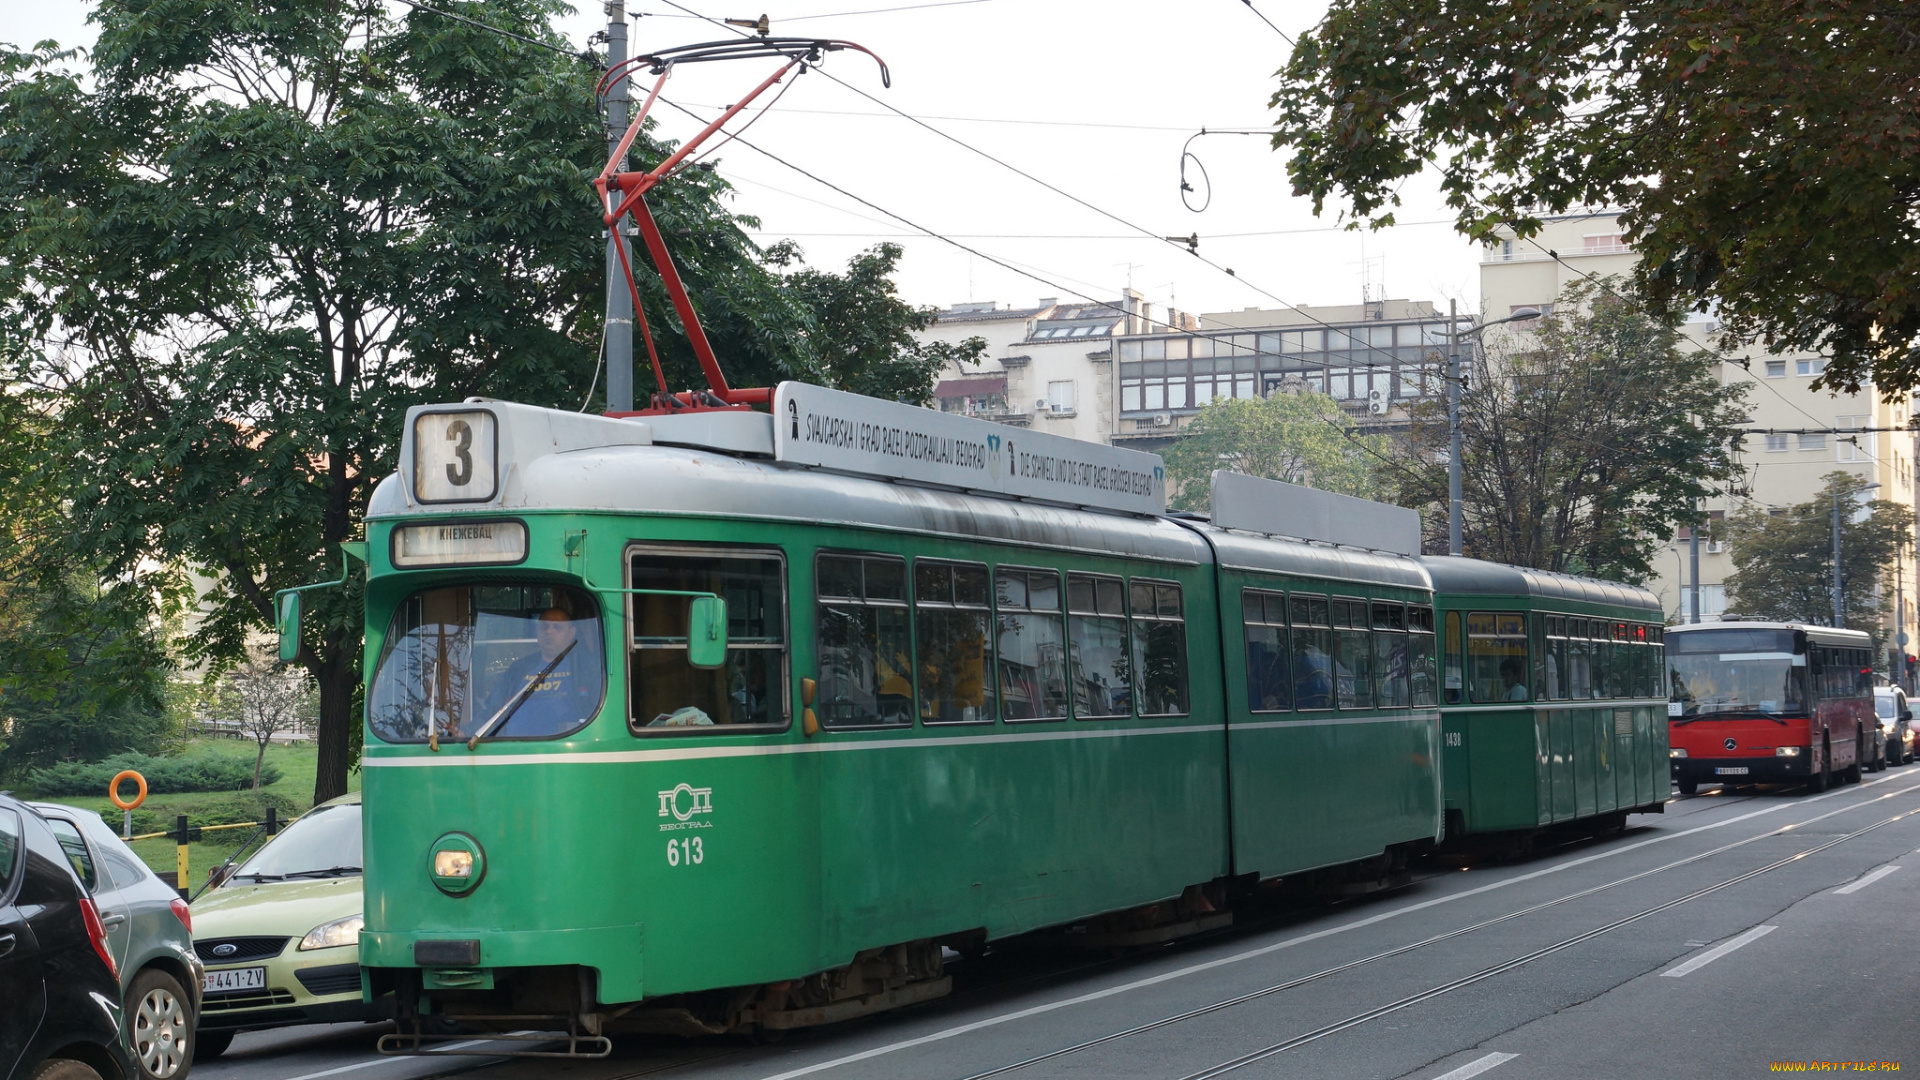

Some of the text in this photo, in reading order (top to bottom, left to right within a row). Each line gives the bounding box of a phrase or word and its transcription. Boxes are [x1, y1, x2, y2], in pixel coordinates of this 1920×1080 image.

[445, 420, 473, 486] 3
[860, 421, 881, 453] GRAD
[882, 425, 904, 457] BAZEL
[905, 429, 954, 465] POZDRAVLJAJU
[955, 439, 986, 470] BEOGRAD
[1020, 451, 1030, 478] DIE
[1031, 454, 1055, 482] SCHWEIZ
[1068, 460, 1077, 485] DIE
[1077, 462, 1093, 488] STADT
[1093, 465, 1109, 490] BASEL
[439, 525, 493, 541] КНЕЖЕВАЦ
[658, 782, 713, 822] ГСП
[659, 820, 713, 831] БЕОГРАД
[667, 836, 704, 867] 613
